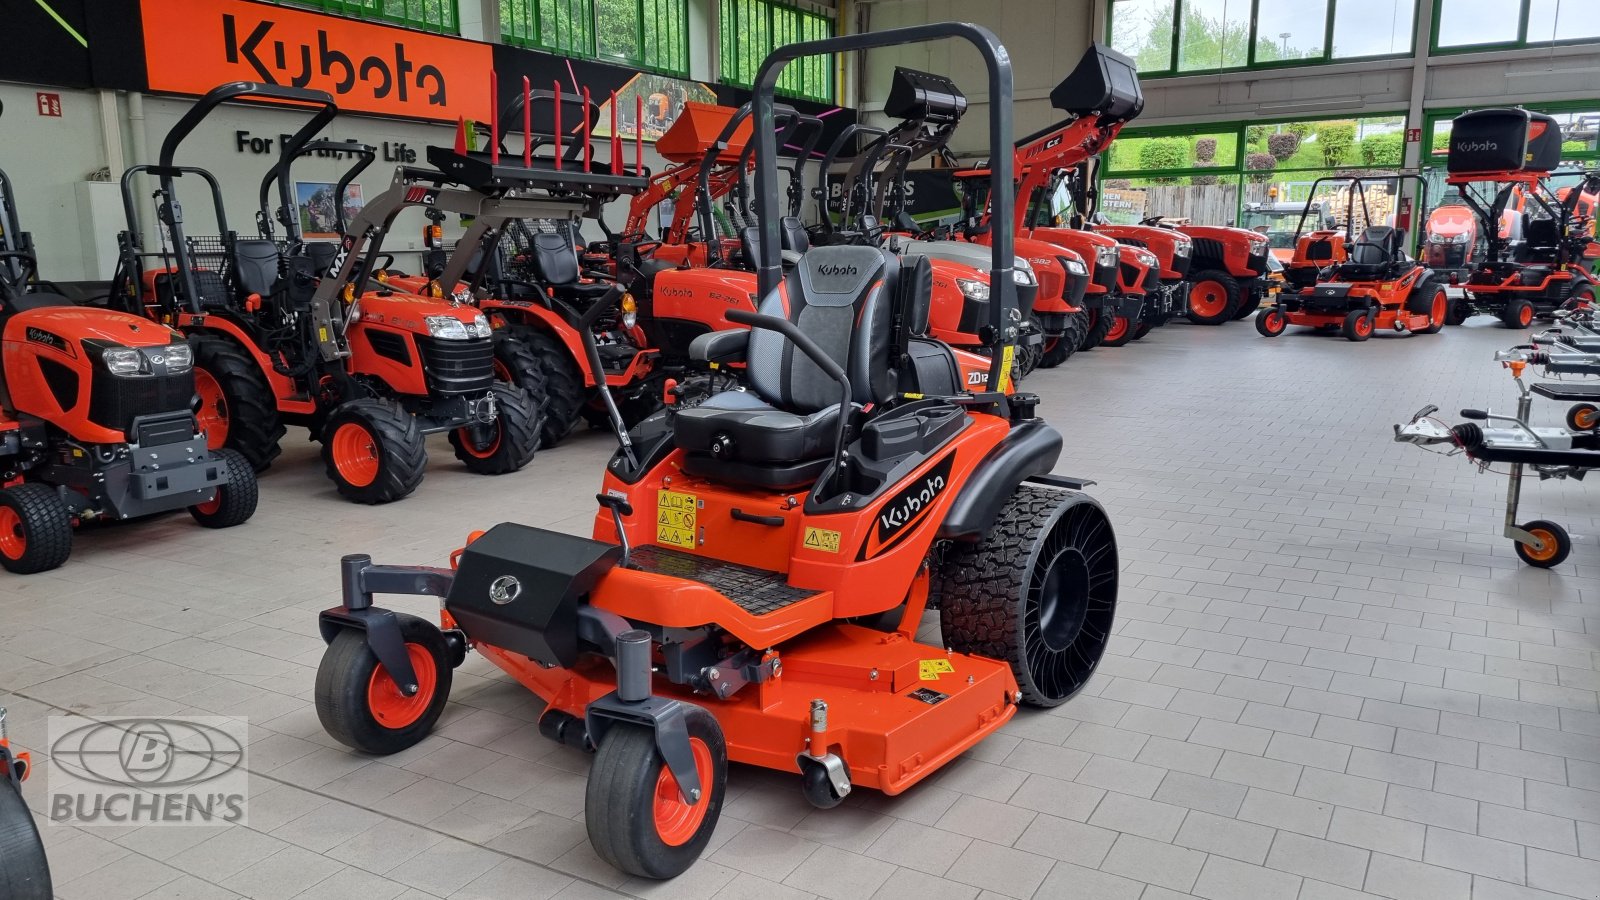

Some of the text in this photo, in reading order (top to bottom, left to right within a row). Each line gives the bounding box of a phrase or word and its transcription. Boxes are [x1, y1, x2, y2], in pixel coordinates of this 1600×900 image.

[222, 13, 447, 107] Kubota
[236, 130, 273, 154] For
[384, 141, 417, 164] Life
[1457, 141, 1498, 152] Kubota
[423, 195, 435, 204] C1
[329, 246, 349, 278] MX
[818, 264, 858, 276] Kubota
[660, 286, 693, 298] Kubota
[29, 328, 54, 345] Kubota
[881, 475, 945, 529] Kubota
